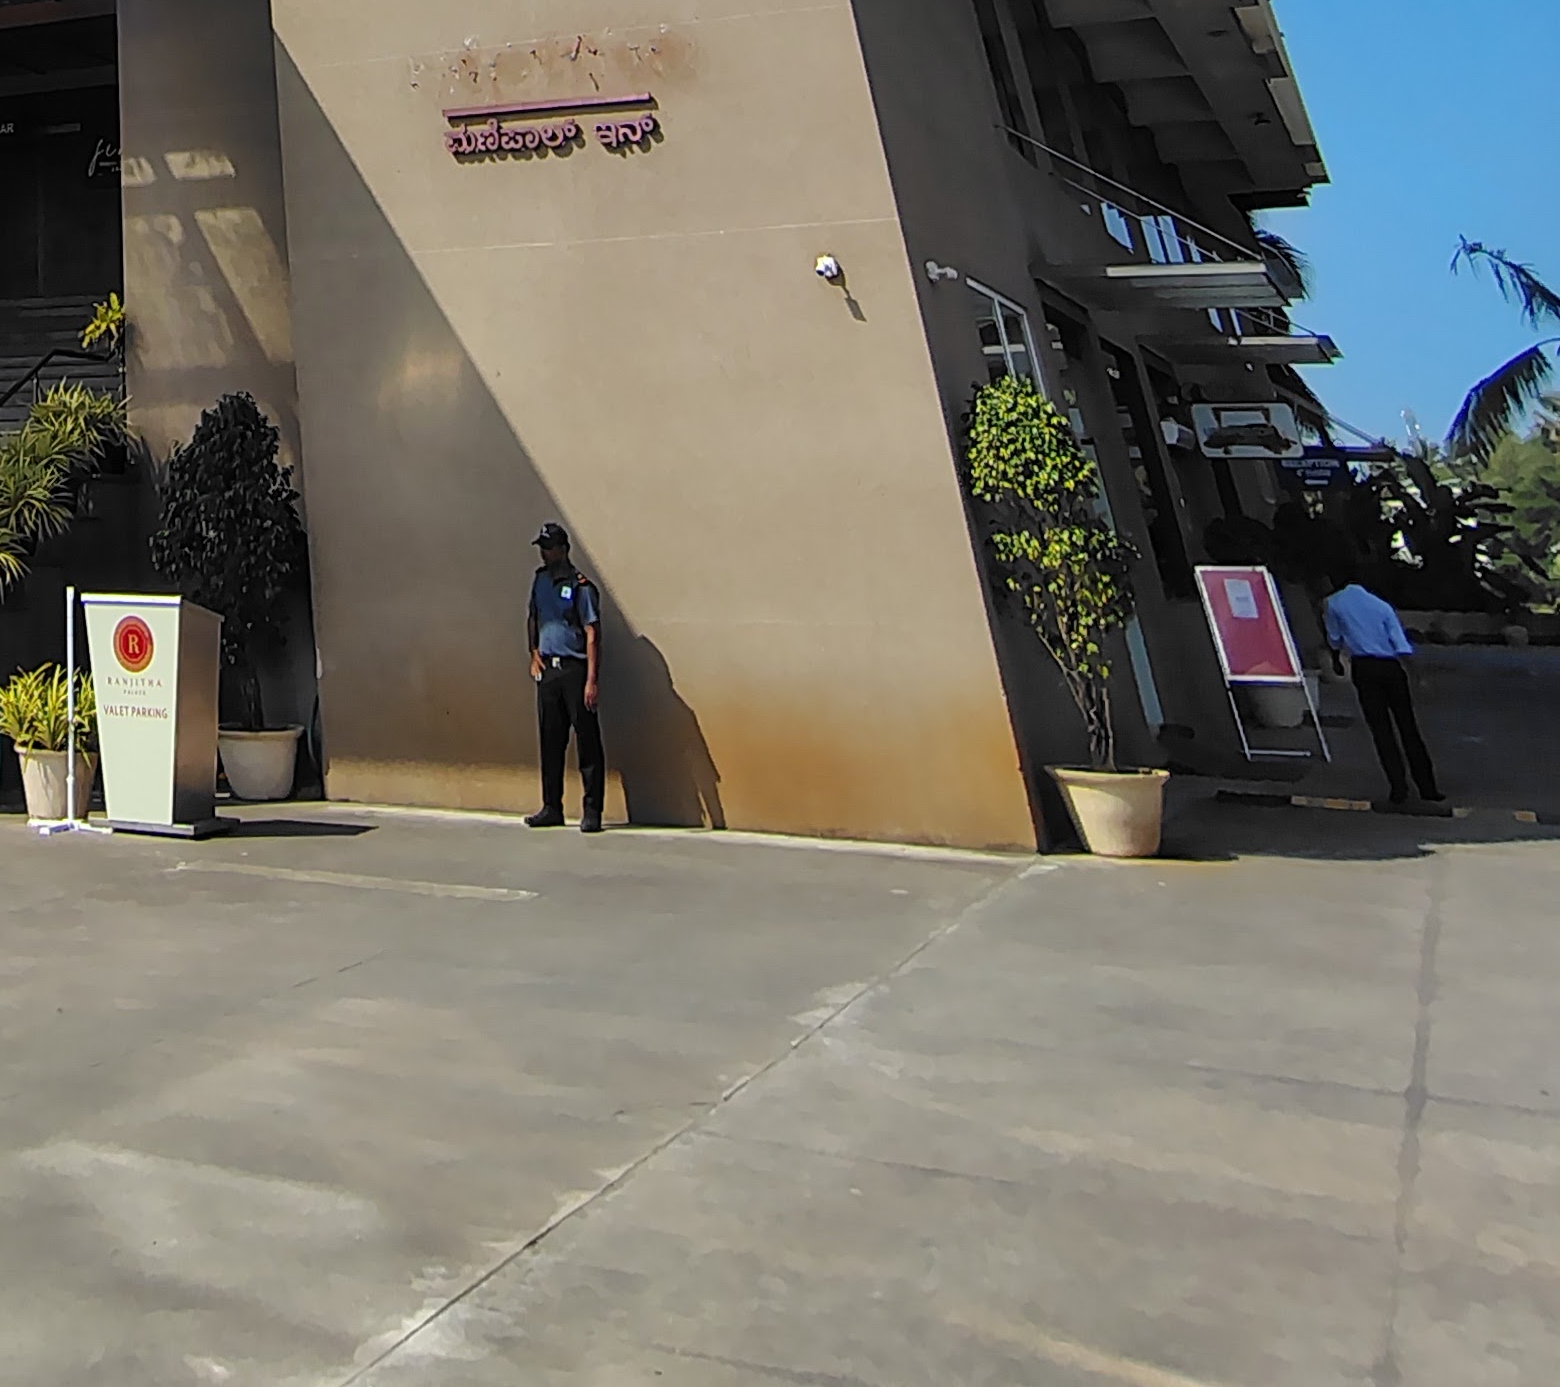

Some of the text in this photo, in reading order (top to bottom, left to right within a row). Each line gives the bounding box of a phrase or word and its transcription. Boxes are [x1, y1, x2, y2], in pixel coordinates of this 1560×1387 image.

[444, 113, 655, 154] ಮಣಿಪಾಲ್ ಇನ್
[107, 676, 163, 688] RANJITHA
[103, 704, 169, 719] VALET PARKING
